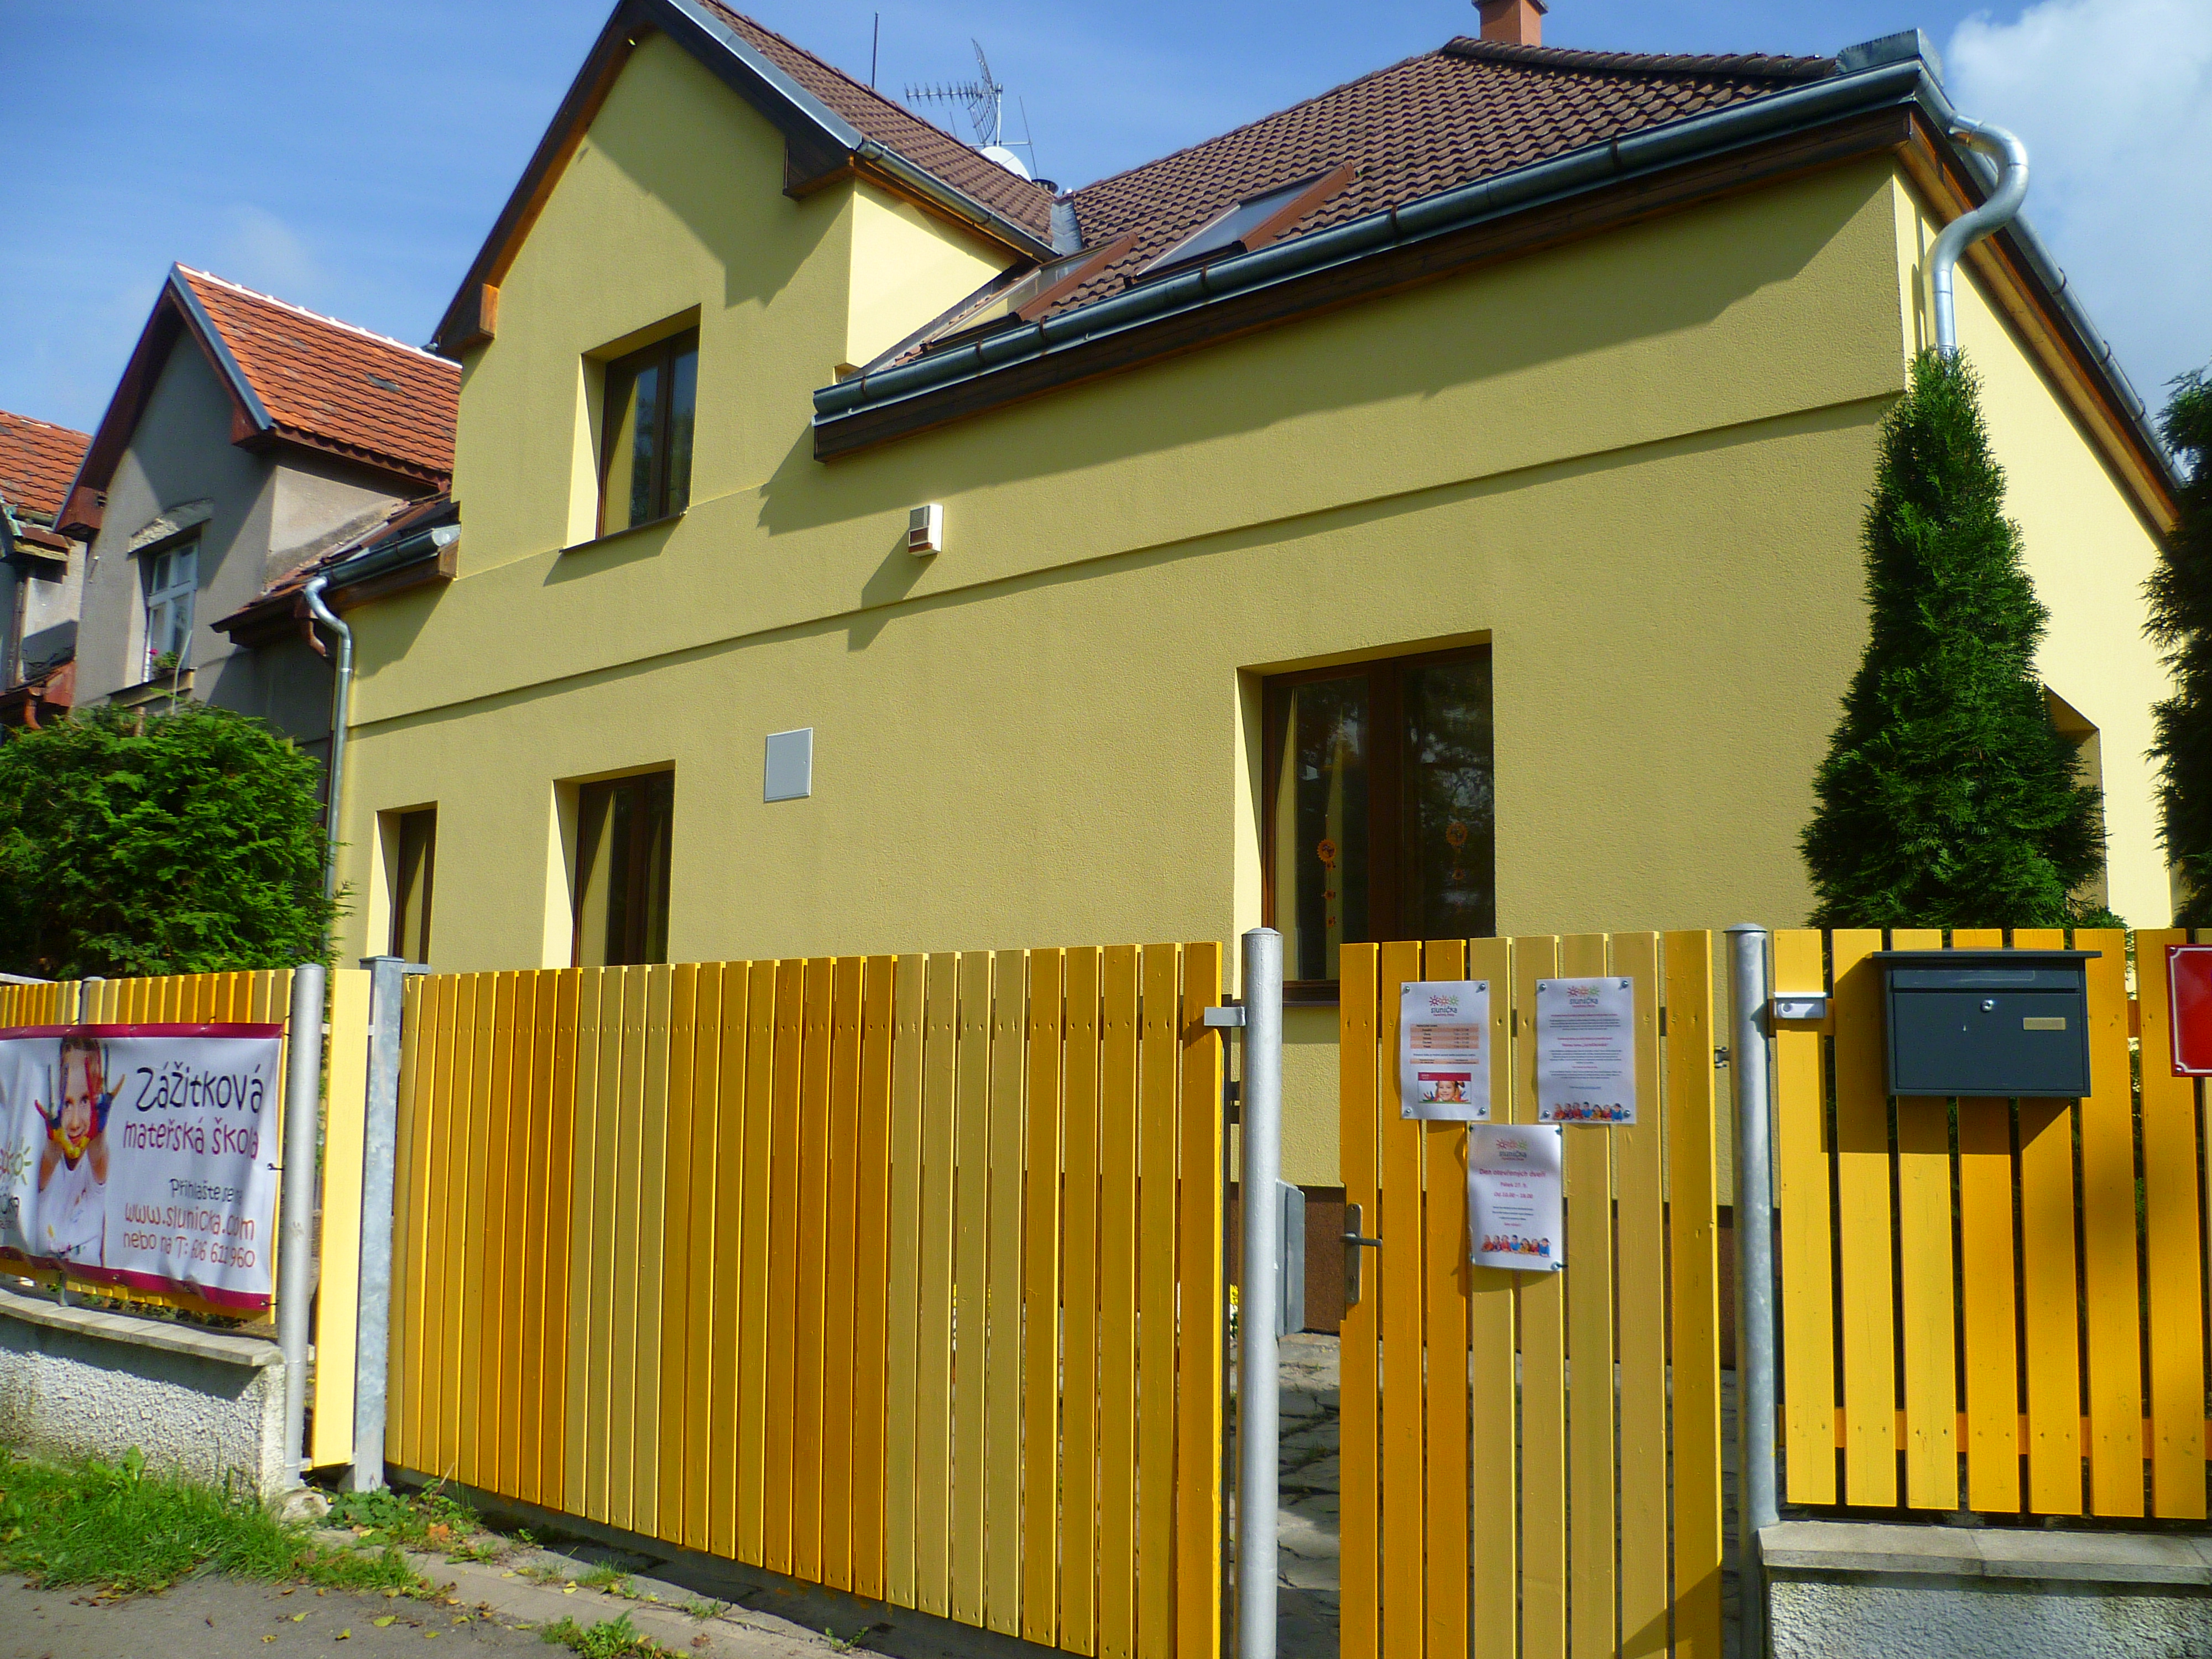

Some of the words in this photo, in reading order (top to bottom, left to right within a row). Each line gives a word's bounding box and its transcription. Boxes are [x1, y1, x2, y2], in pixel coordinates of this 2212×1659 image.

[136, 1061, 263, 1113] Zážitková
[123, 1117, 204, 1155] mateřská
[212, 1117, 259, 1159] škola
[123, 1230, 156, 1250] nebo
[160, 1236, 172, 1254] na
[176, 1236, 188, 1259] T:
[230, 1246, 255, 1268] 960
